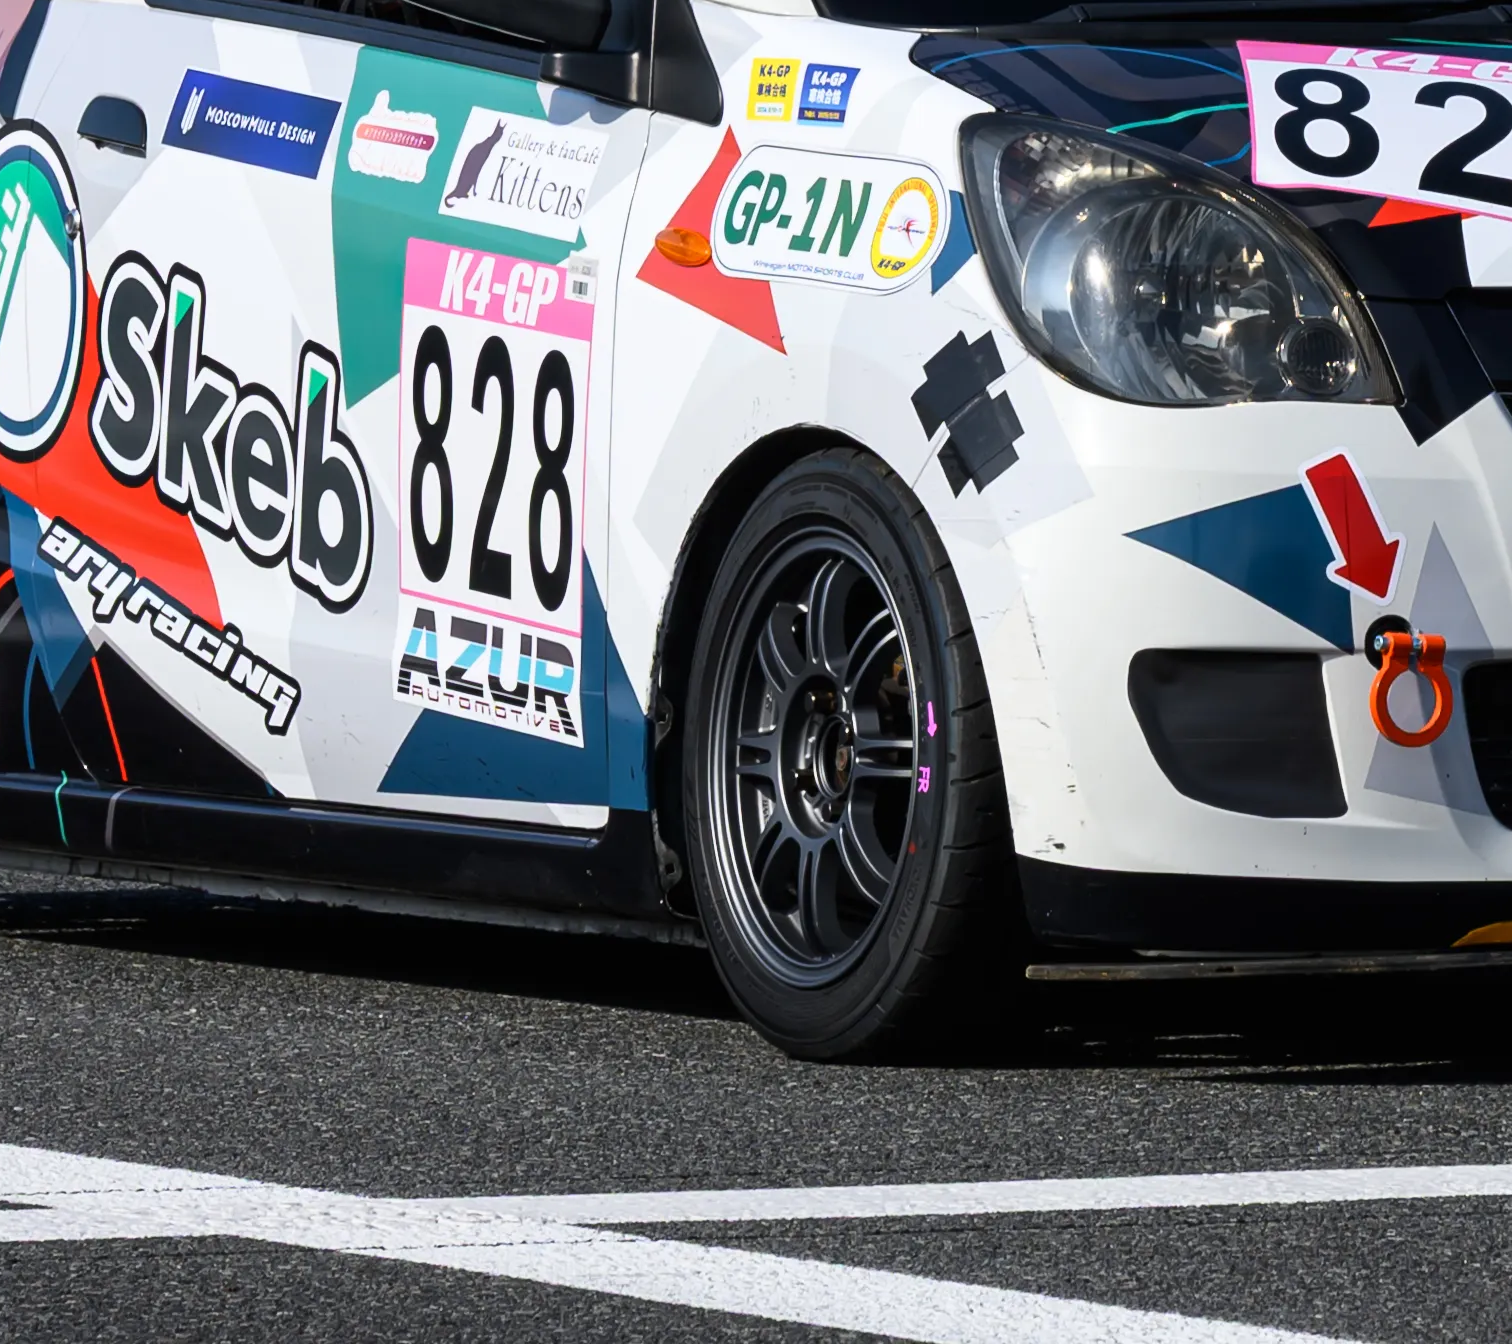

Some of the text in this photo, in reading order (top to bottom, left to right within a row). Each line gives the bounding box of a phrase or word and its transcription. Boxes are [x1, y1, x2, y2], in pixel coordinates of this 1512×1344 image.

[759, 64, 791, 77] K4-GP
[811, 70, 848, 87] K4-GP
[507, 131, 545, 159] Gallery
[546, 141, 558, 156] &
[488, 156, 586, 220] Kittens
[724, 170, 873, 257] GP-1N
[439, 249, 560, 327] K4-GP
[92, 261, 370, 603] Skeb
[411, 325, 575, 612] 828
[397, 607, 579, 738] AZUR
[411, 684, 561, 733] AUTOMOTIVE
[916, 766, 931, 795] FR
